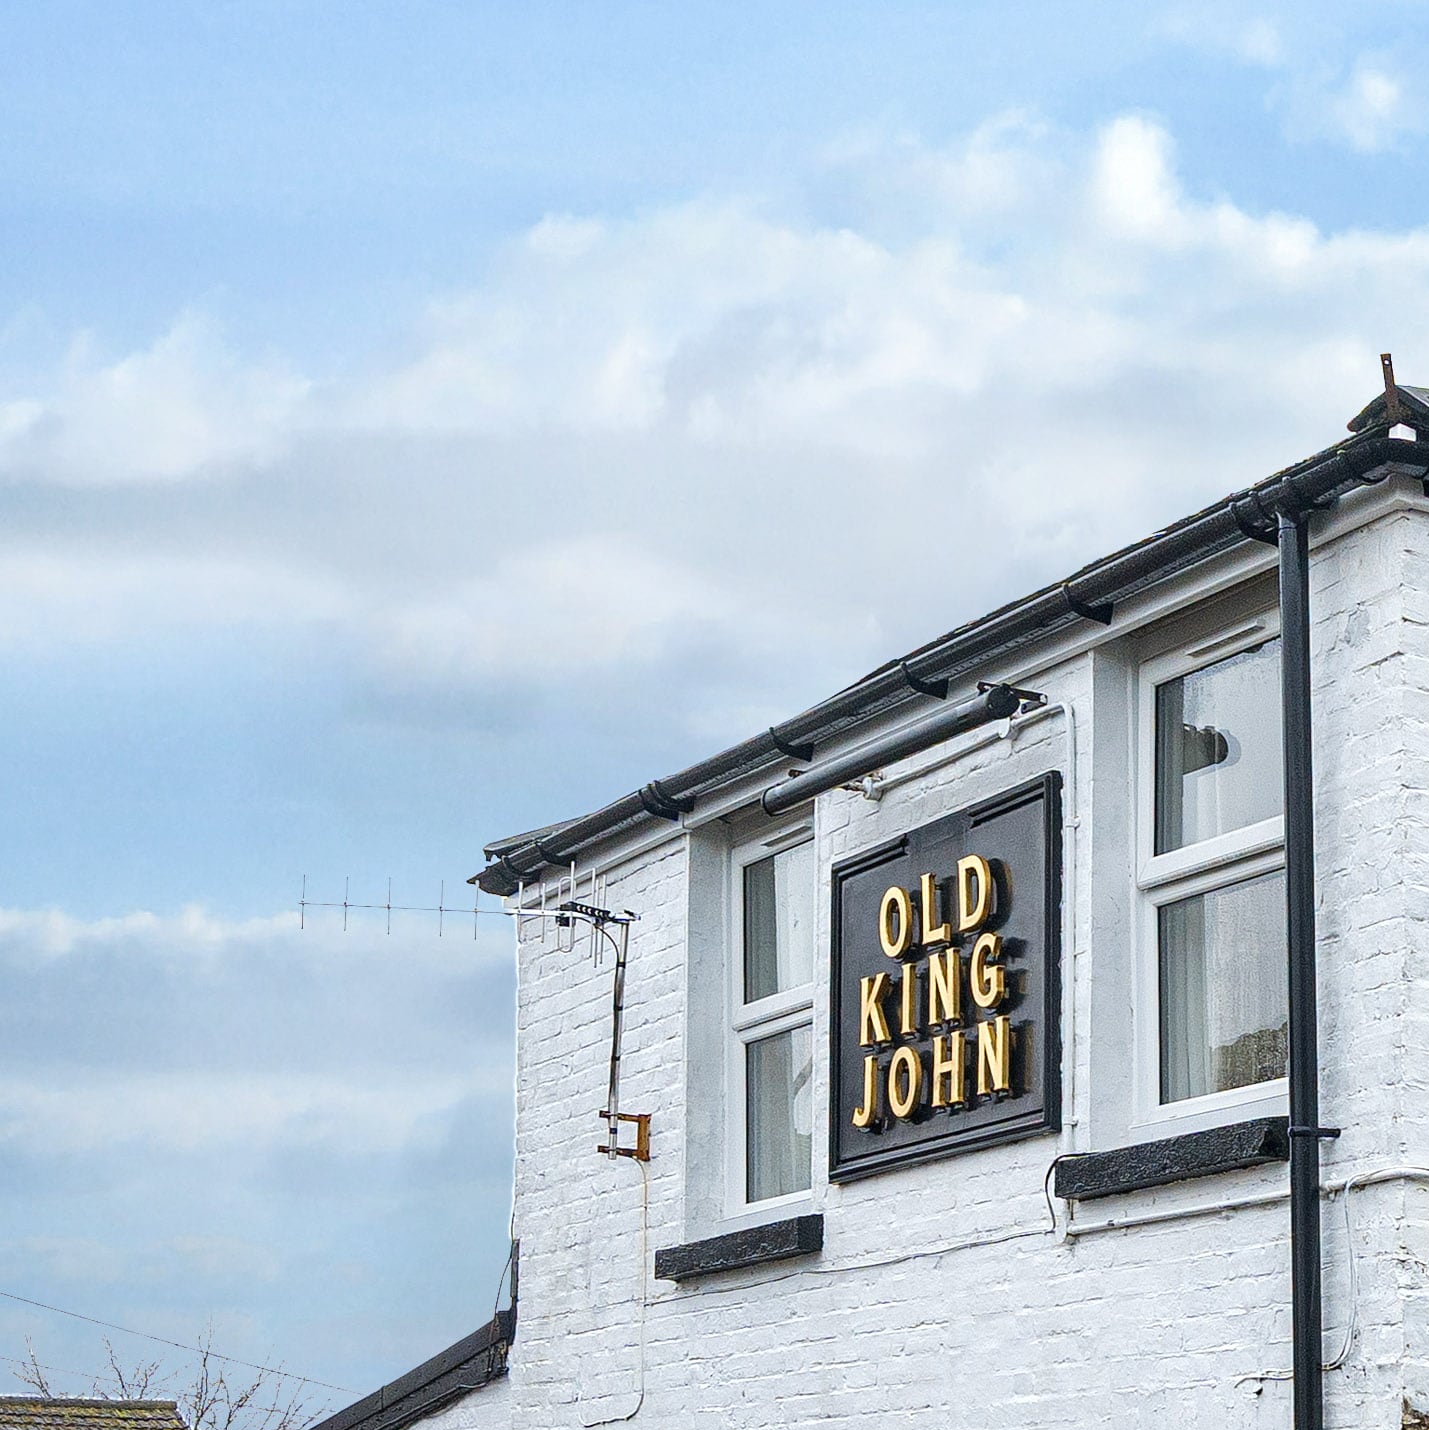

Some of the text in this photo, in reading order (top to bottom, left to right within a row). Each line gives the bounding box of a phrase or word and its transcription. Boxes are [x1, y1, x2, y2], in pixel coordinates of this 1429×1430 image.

[878, 853, 991, 959] OLD
[859, 931, 1004, 1047] KING
[852, 1015, 1010, 1128] JOHN
